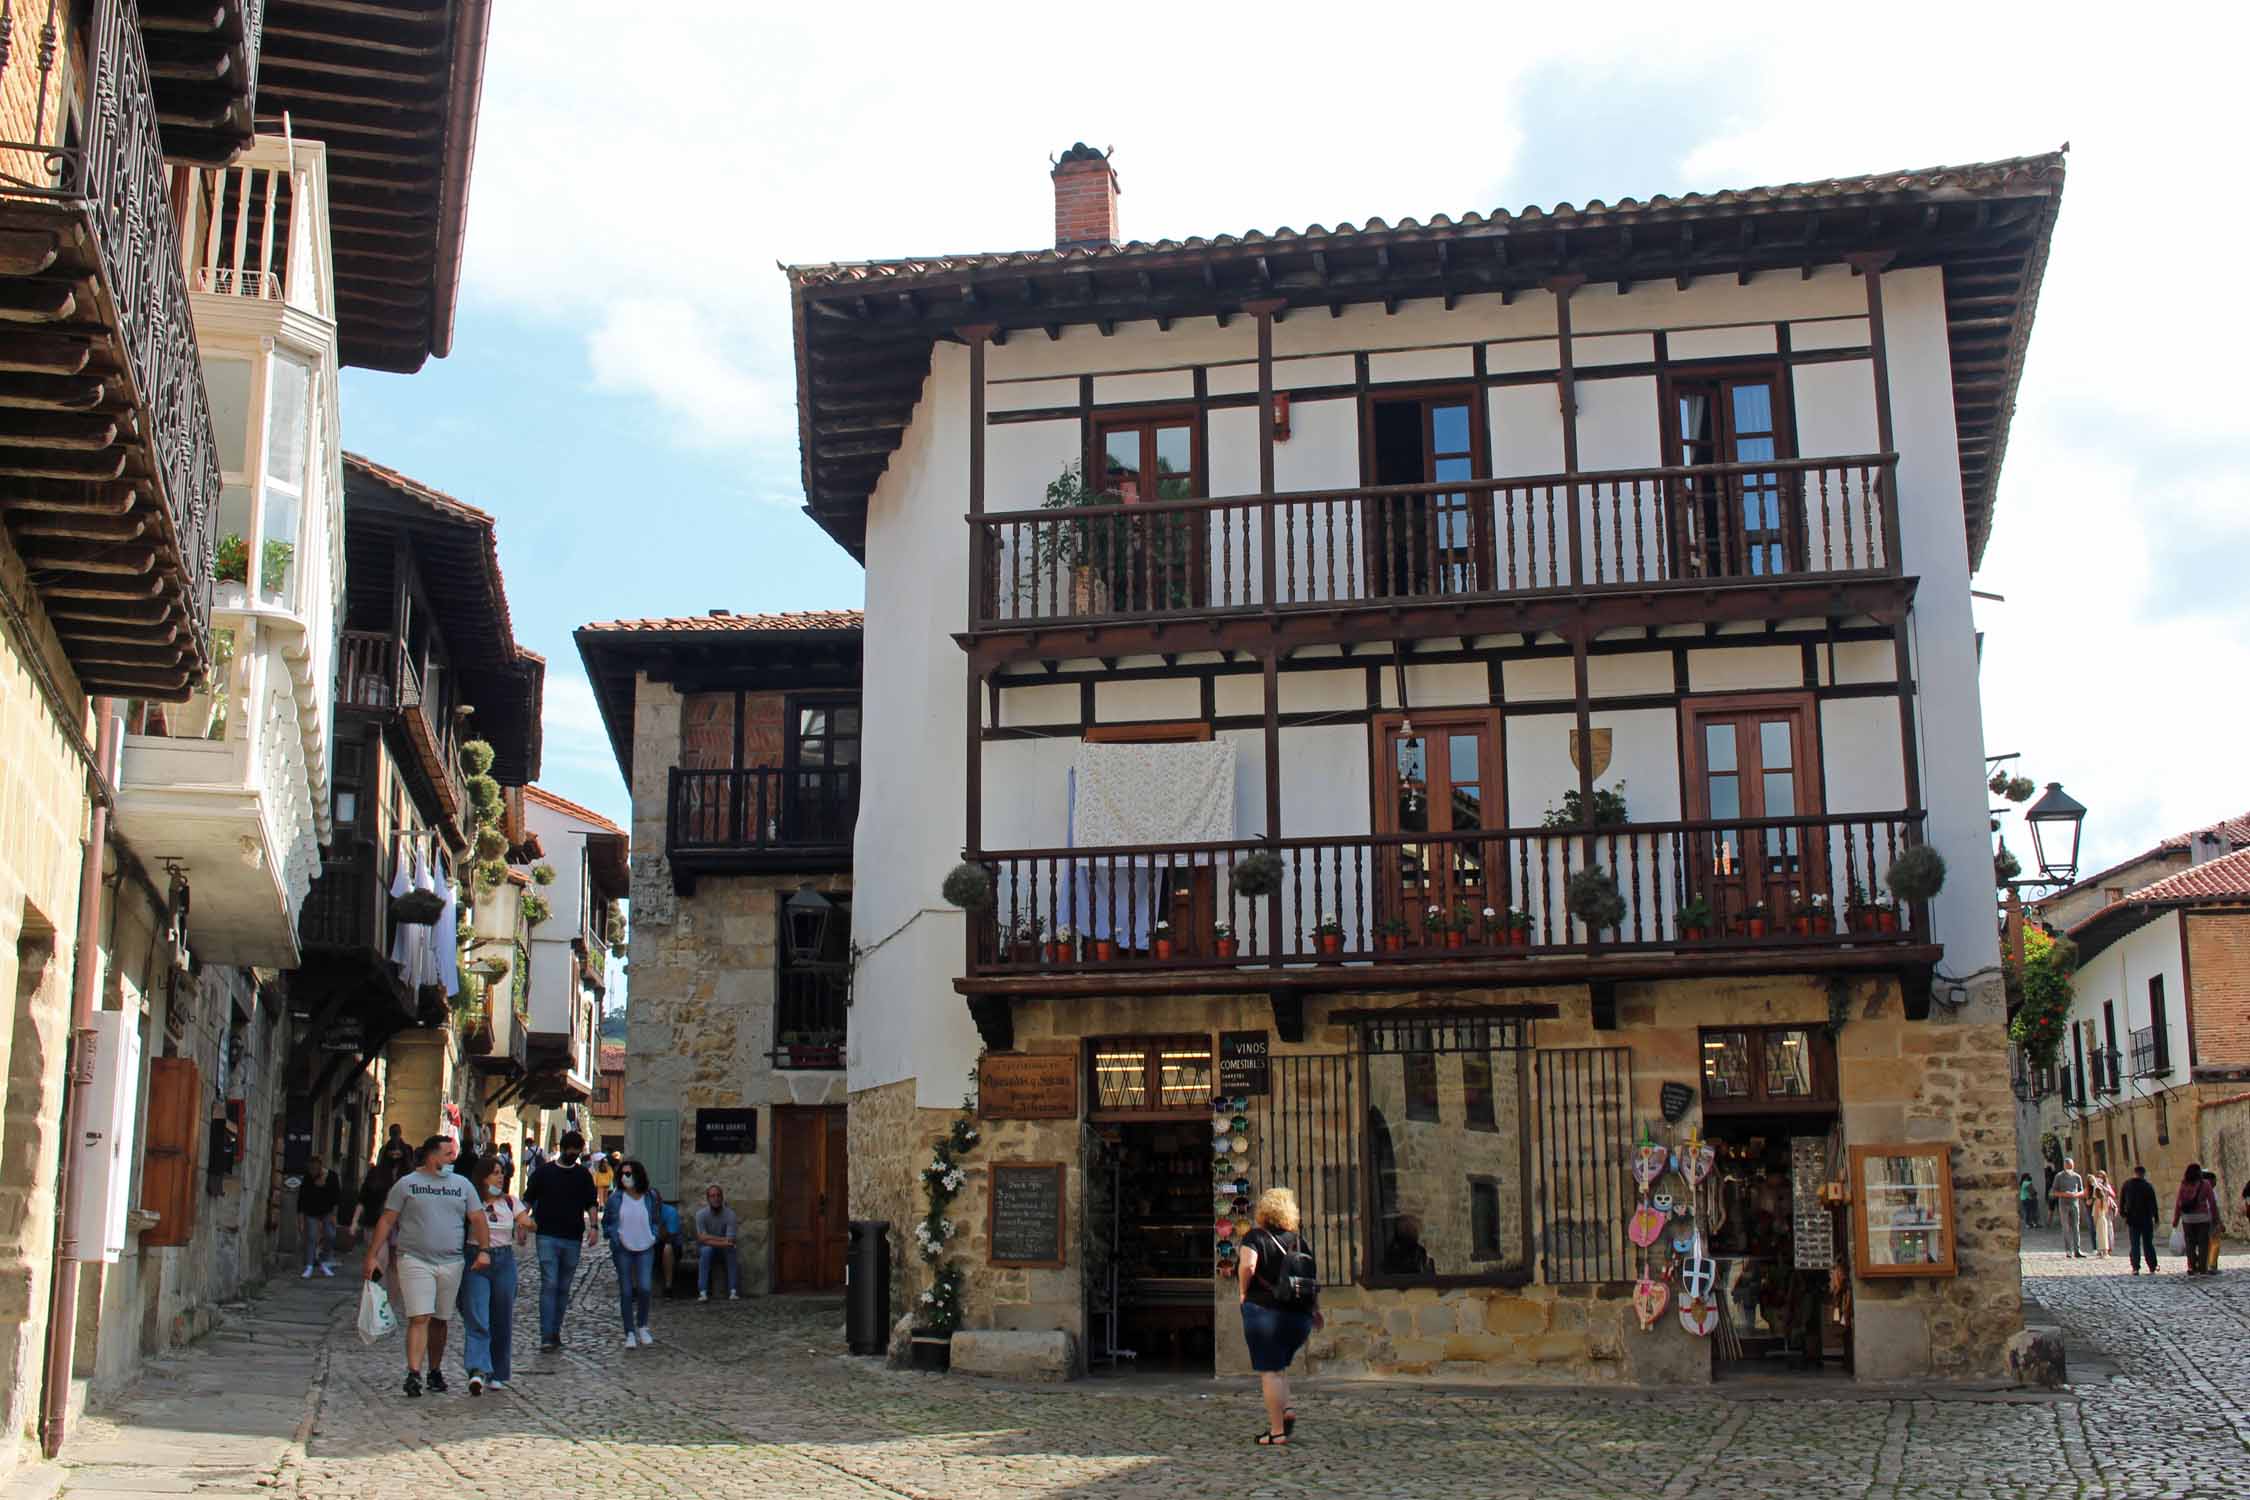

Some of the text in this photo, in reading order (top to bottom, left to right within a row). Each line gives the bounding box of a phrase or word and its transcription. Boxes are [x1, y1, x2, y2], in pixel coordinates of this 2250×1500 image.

[1236, 1042, 1266, 1054] VINOS
[1220, 1058, 1265, 1071] COMESTIBLES
[409, 1183, 462, 1198] Timberland
